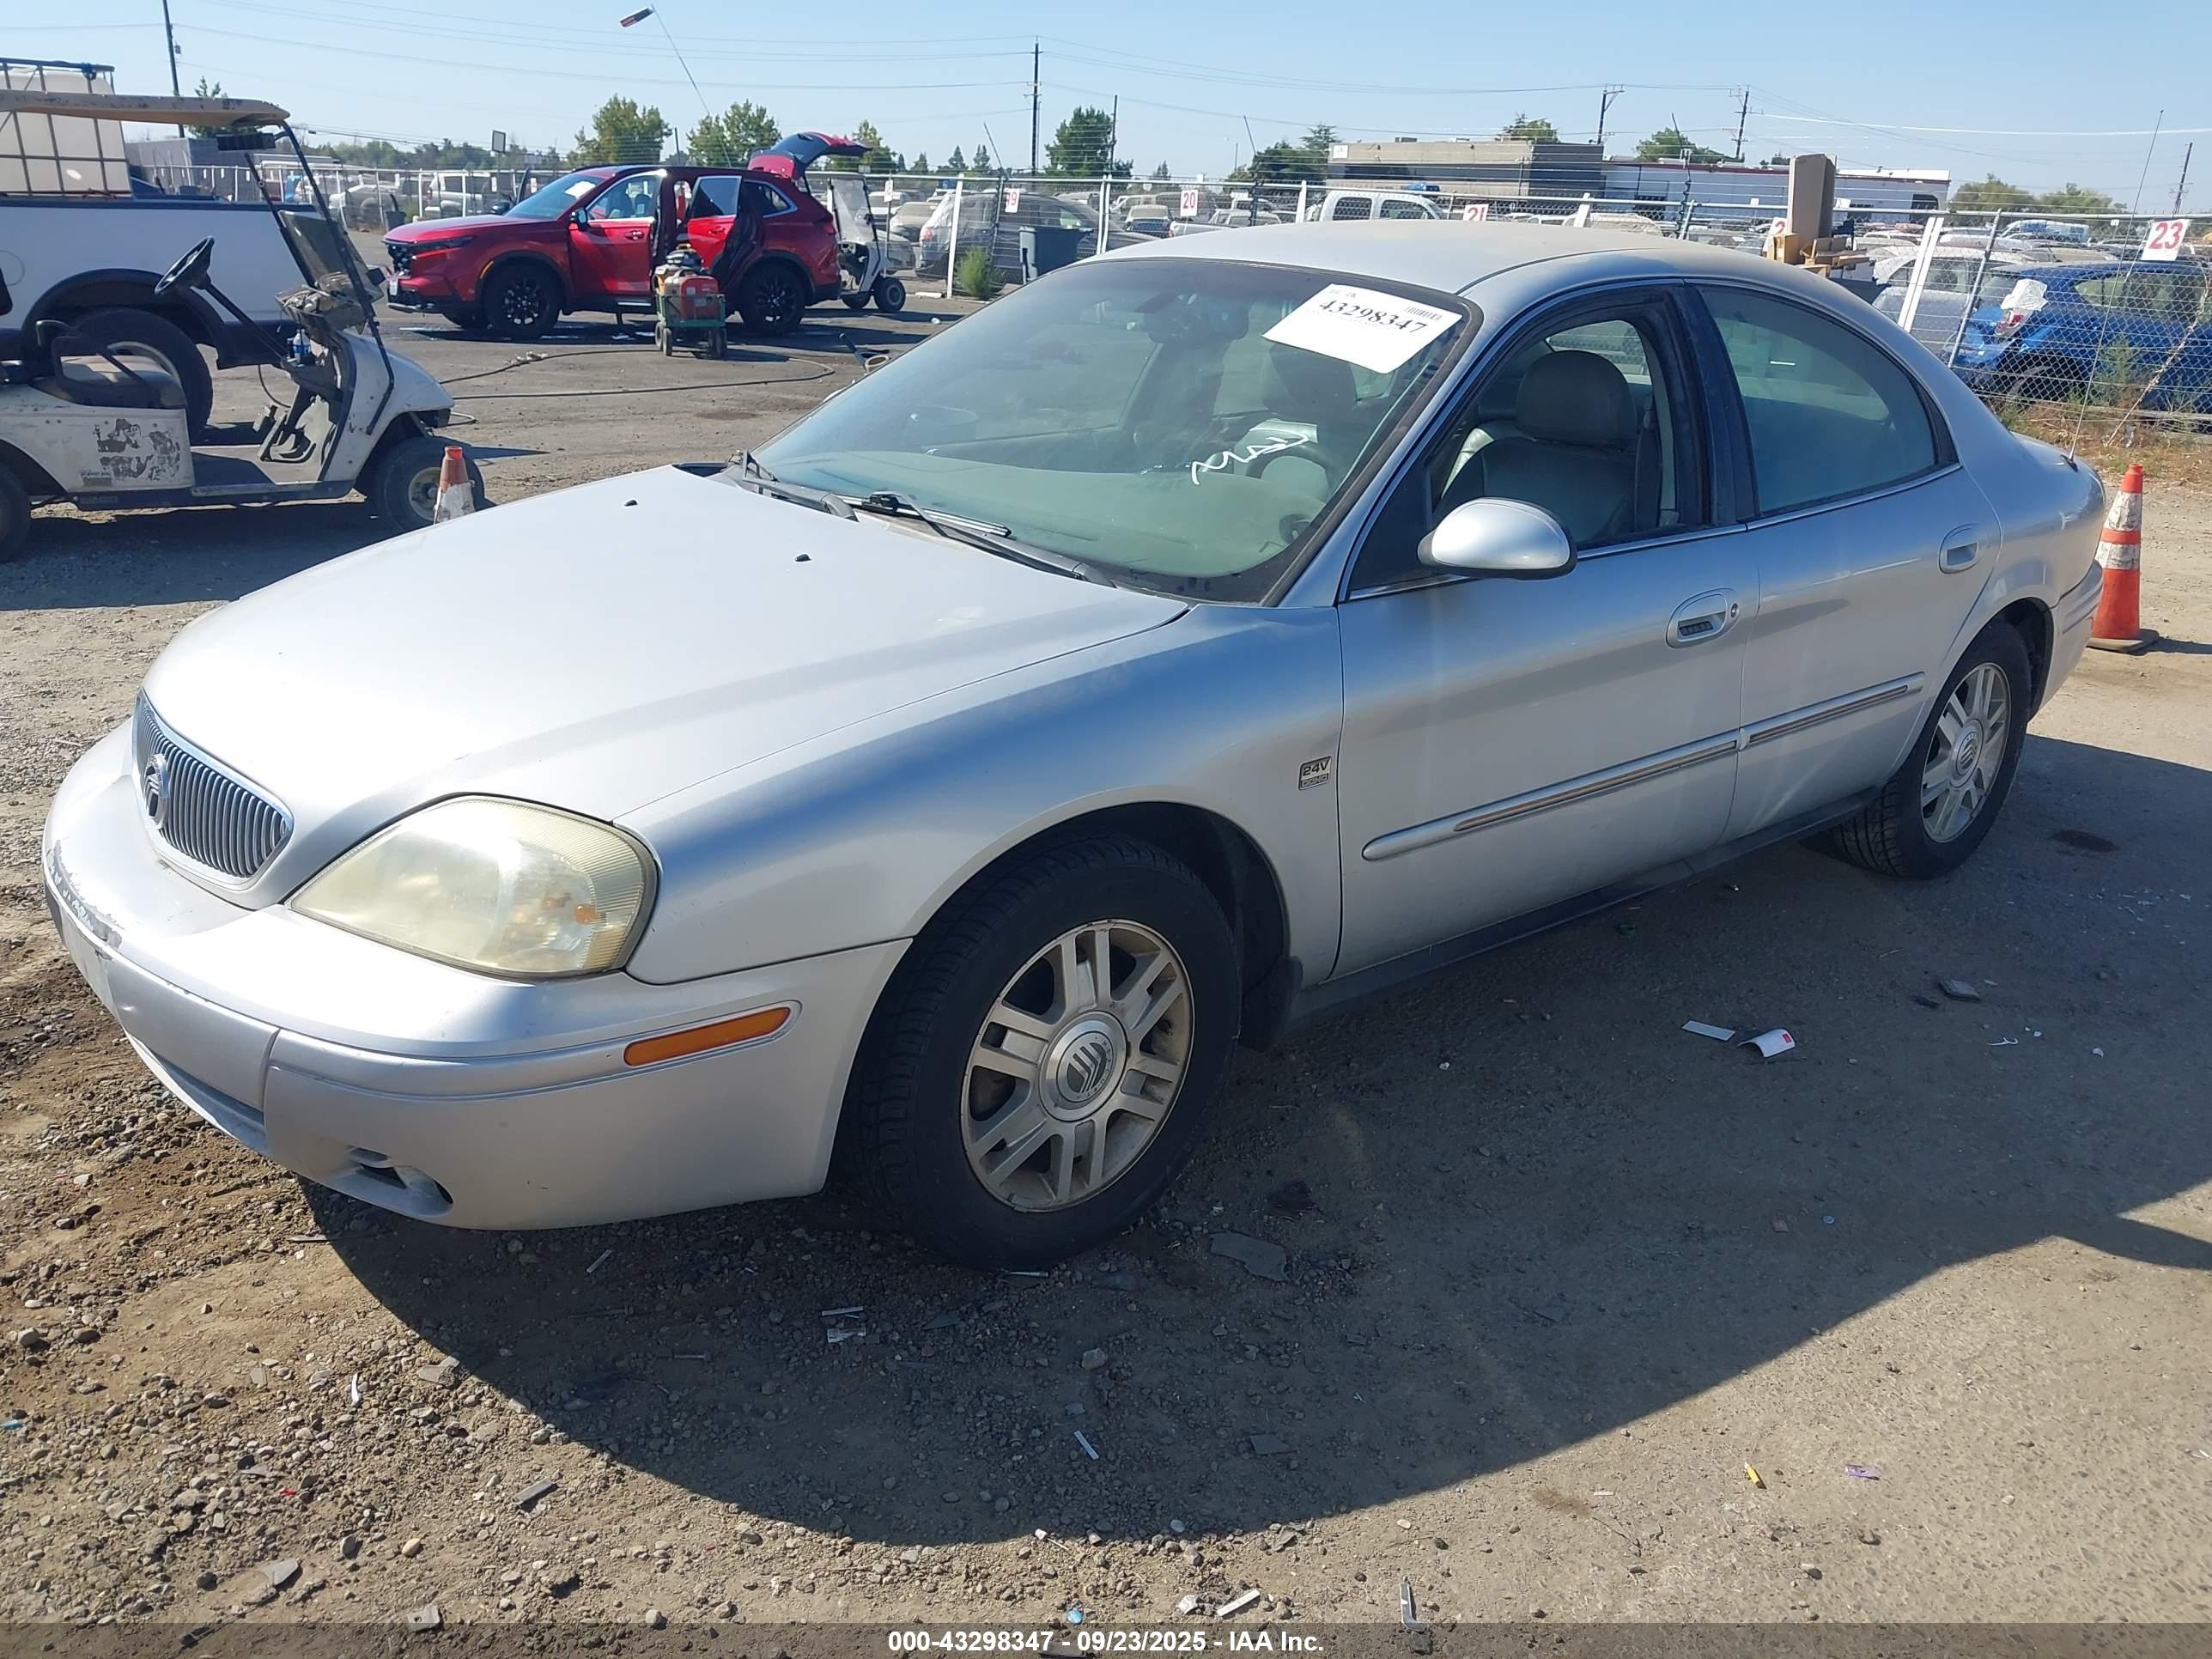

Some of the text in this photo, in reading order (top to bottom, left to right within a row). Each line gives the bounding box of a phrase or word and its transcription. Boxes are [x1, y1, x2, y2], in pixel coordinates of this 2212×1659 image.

[1182, 191, 1196, 210] 20
[2148, 221, 2184, 250] 23
[1319, 300, 1428, 334] 43298347
[1302, 759, 1330, 777] 24V
